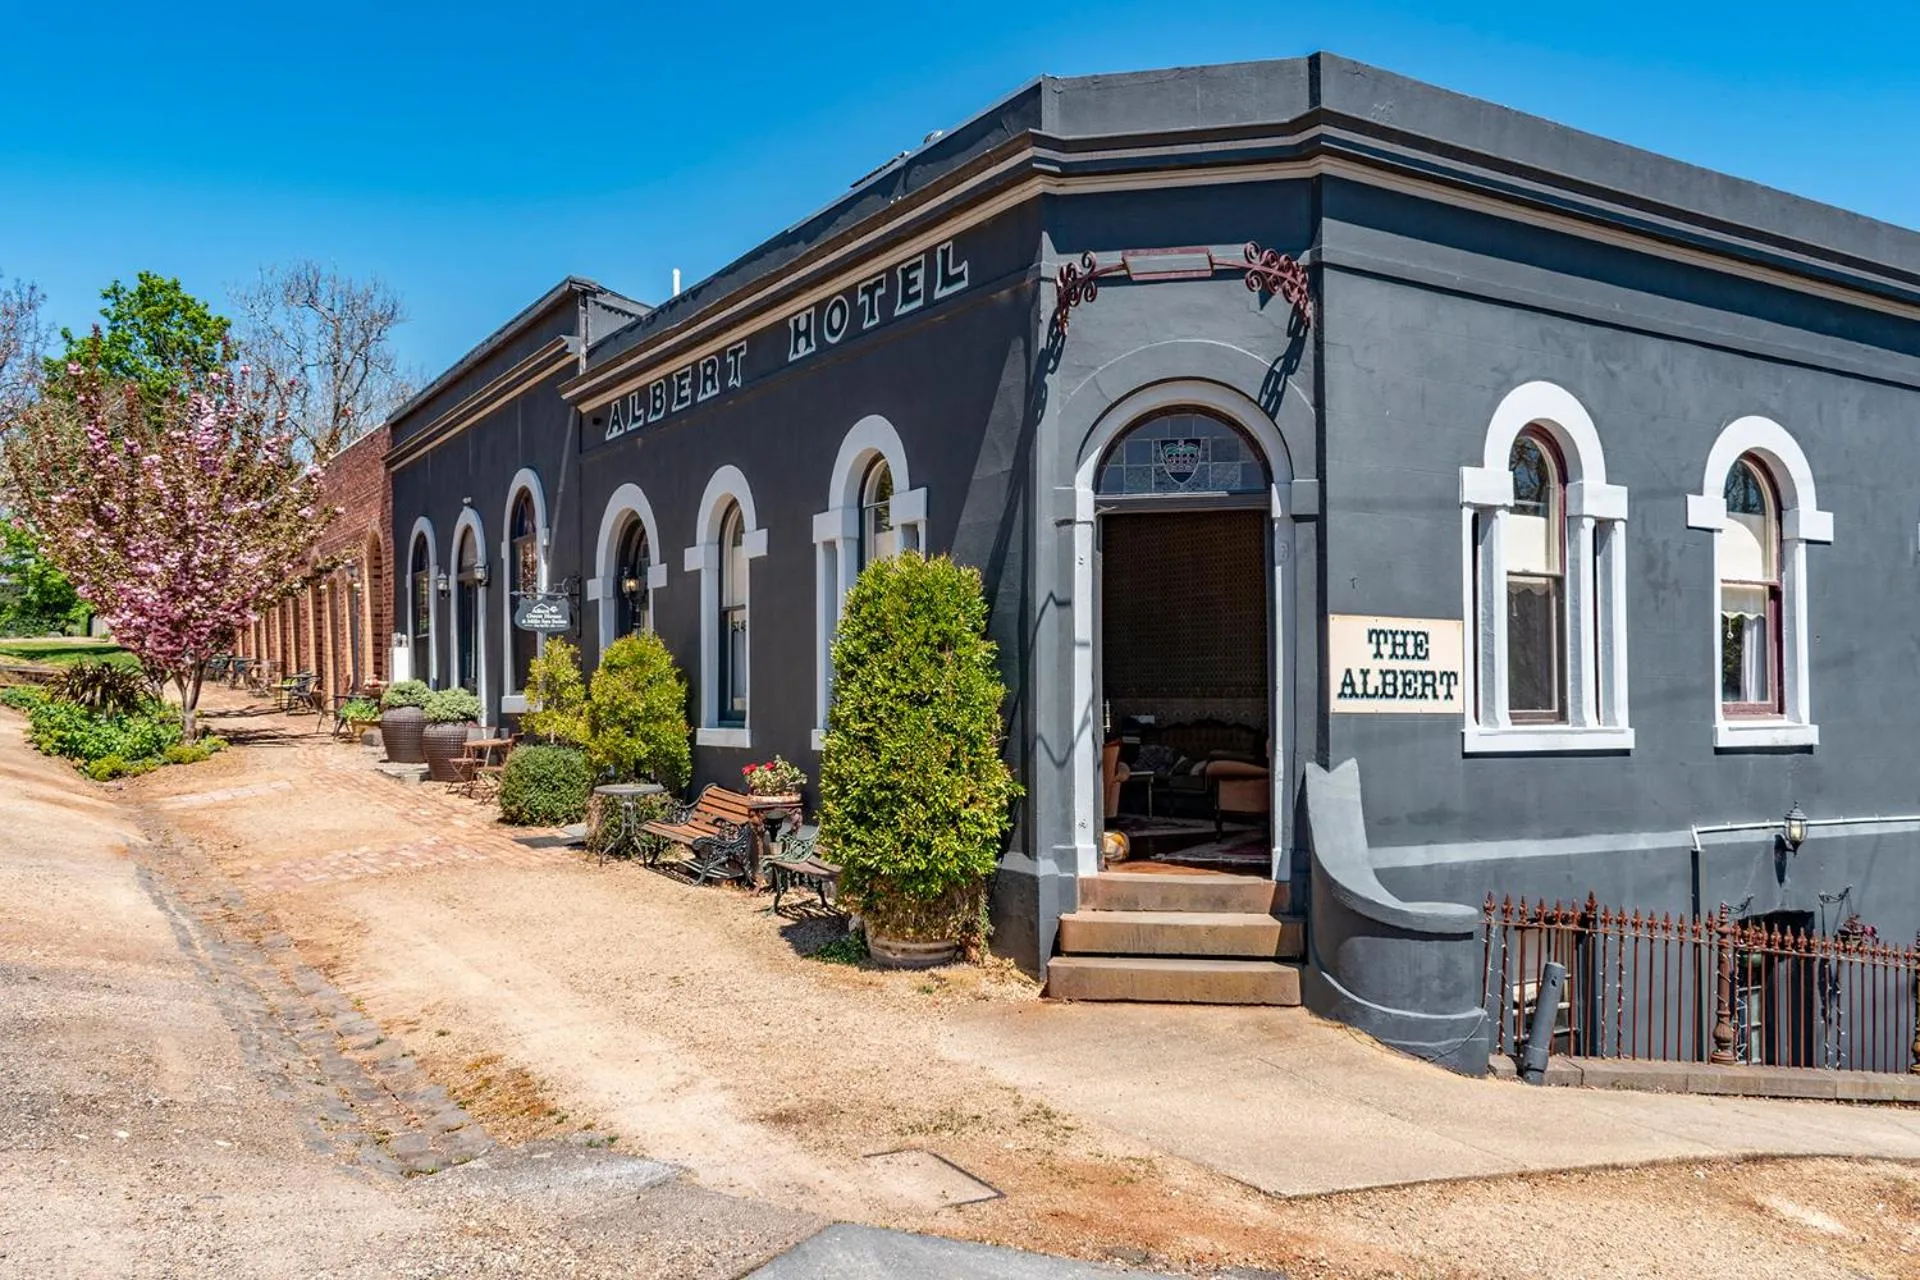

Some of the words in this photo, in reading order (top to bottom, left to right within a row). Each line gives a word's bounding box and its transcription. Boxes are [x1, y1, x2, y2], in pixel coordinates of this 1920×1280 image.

[605, 340, 747, 441] ALBERT
[788, 241, 969, 363] HOTEL
[1367, 628, 1429, 661] THE
[1337, 668, 1458, 701] ALBERT
